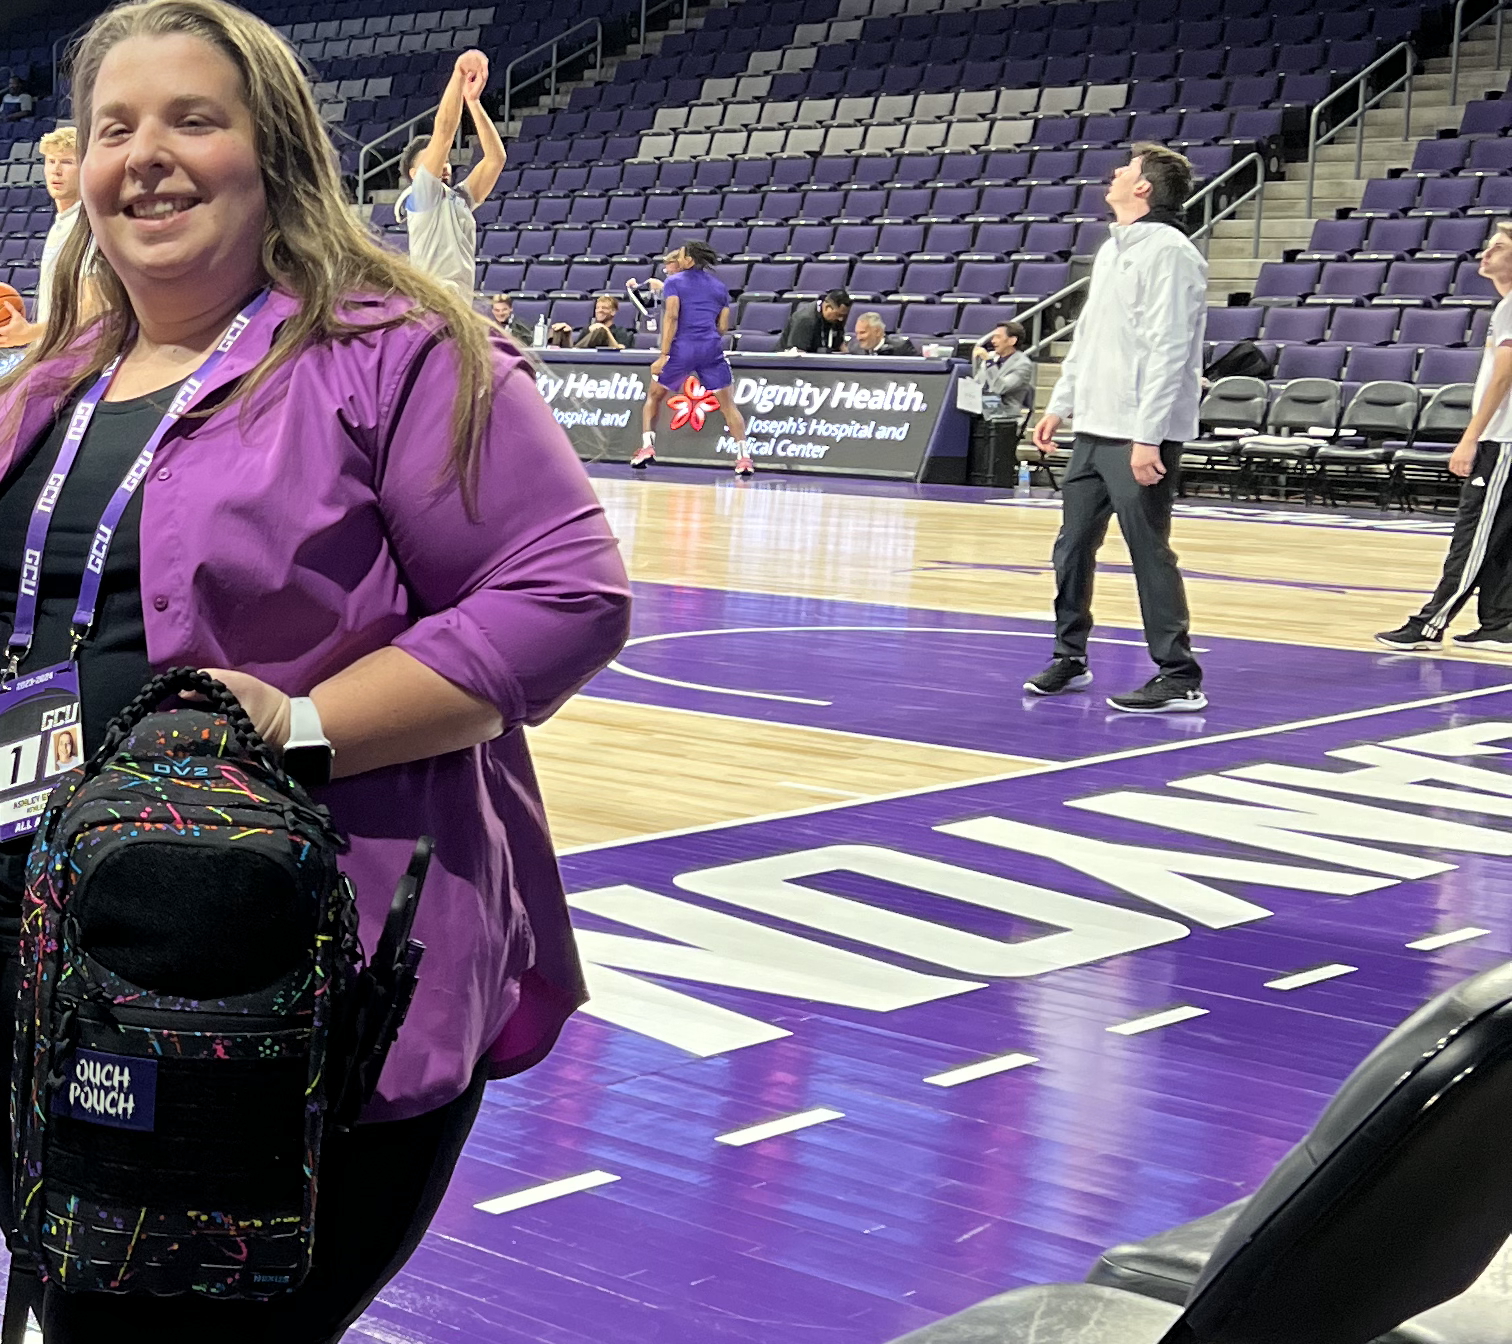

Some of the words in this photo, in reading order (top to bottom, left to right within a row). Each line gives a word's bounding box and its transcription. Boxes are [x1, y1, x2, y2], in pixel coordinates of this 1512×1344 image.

[216, 314, 250, 353] GCU
[167, 377, 203, 419] GCU
[734, 377, 829, 416] Dignity
[68, 402, 94, 441] GCU
[600, 409, 631, 427] and
[746, 415, 806, 436] Joseph's
[808, 420, 873, 442] Hospital
[875, 422, 910, 441] and
[777, 440, 830, 459] Center
[121, 449, 154, 494] GCU
[36, 473, 65, 514] GCU
[87, 524, 112, 575] GCU
[21, 548, 40, 597] GCU
[41, 702, 80, 732] GCU
[10, 745, 22, 786] 1
[153, 763, 209, 777] DV2
[14, 819, 33, 834] ALL
[76, 1058, 131, 1090] OUCH
[69, 1082, 135, 1120] POUCH
